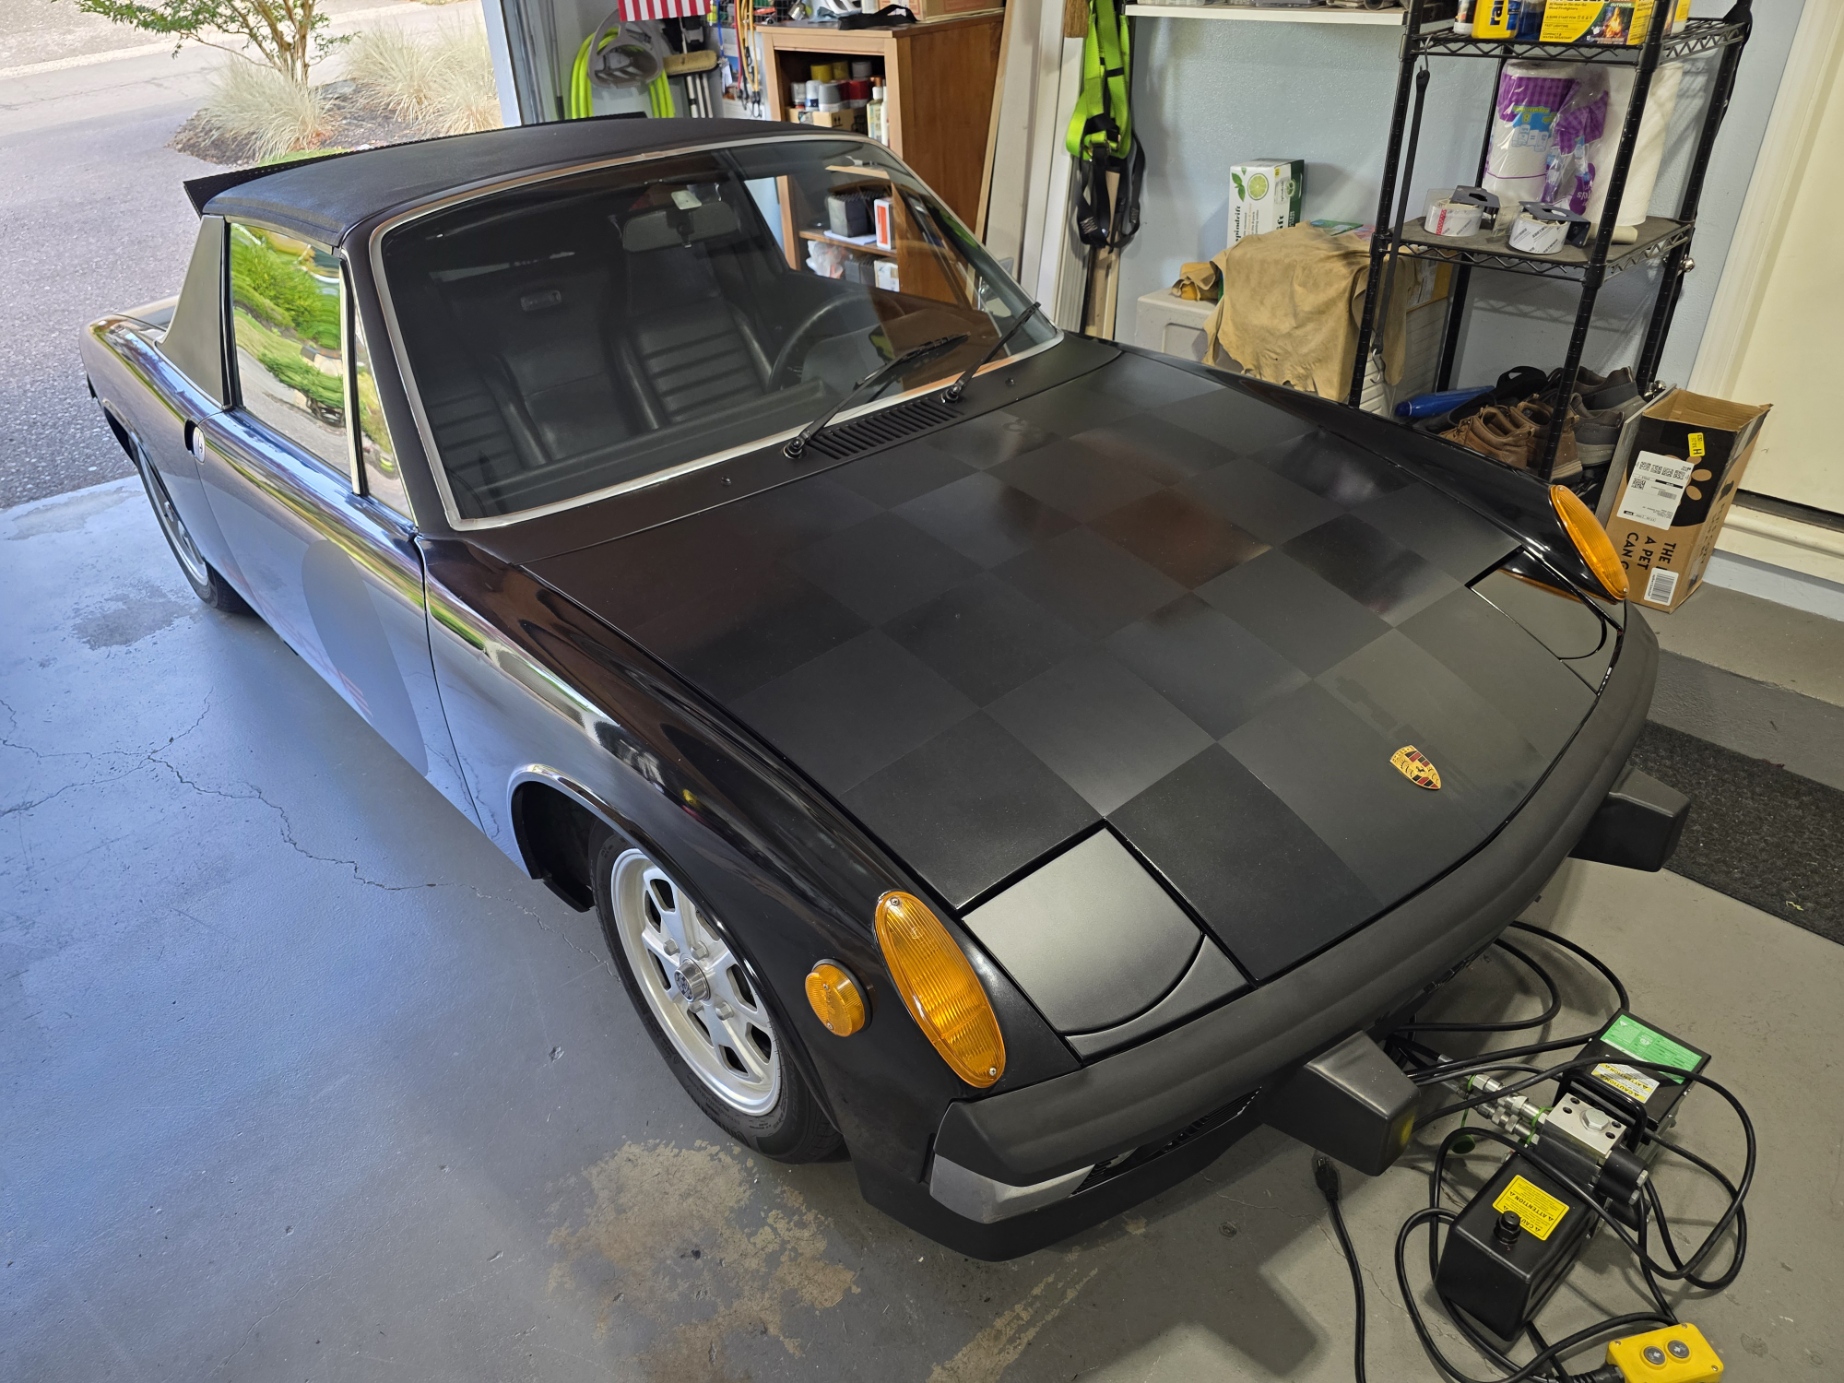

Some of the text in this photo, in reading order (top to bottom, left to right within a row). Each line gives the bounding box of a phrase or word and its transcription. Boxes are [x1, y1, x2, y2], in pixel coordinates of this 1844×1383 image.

[1621, 531, 1639, 558] CAN
[1644, 535, 1657, 545] A
[1637, 548, 1654, 570] PET
[1658, 542, 1677, 564] THE
[1604, 1077, 1633, 1095] CAUTION
[1515, 1195, 1548, 1219] ATTENTION
